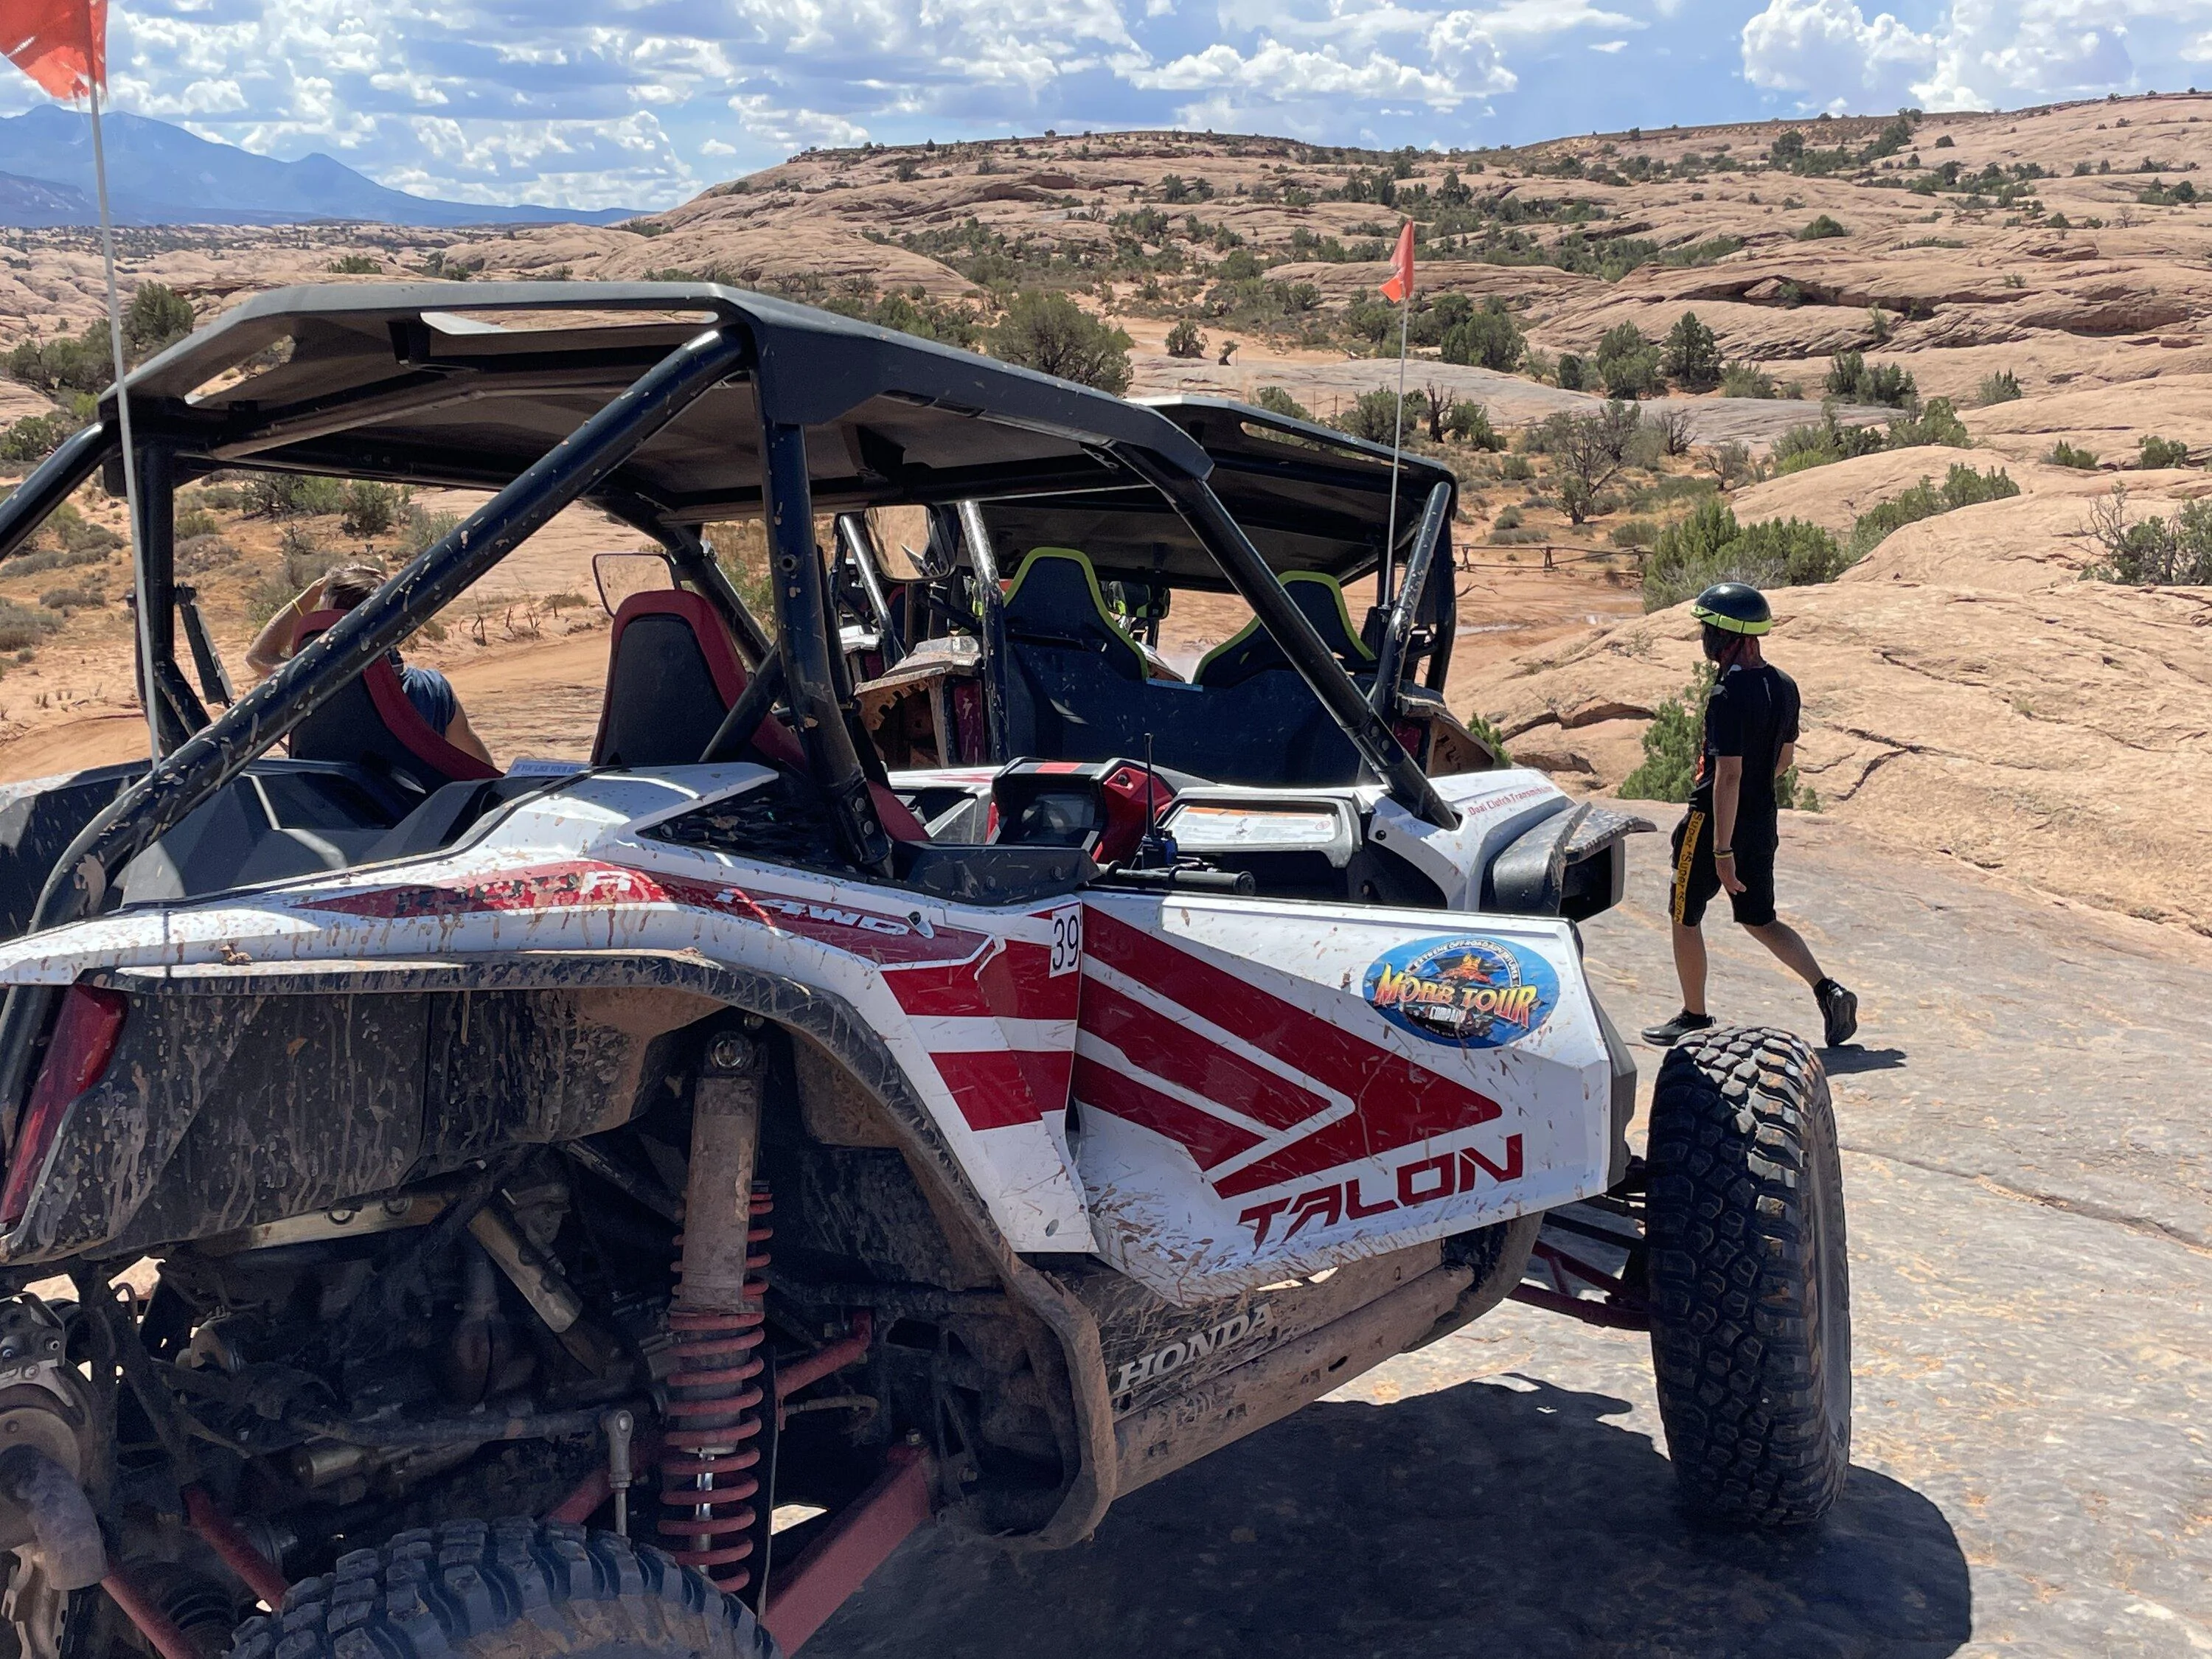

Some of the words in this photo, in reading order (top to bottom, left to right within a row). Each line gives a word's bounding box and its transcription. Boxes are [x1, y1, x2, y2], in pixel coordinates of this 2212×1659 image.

[1467, 803, 1487, 815] Dual
[1486, 796, 1512, 809] Clutch
[1052, 915, 1079, 970] 39
[1413, 942, 1449, 967] EXTREME
[1374, 962, 1455, 1006] MOAB
[1461, 984, 1537, 1029] TOUR
[1237, 1133, 1523, 1254] TALON
[1113, 1303, 1275, 1394] HONDA
